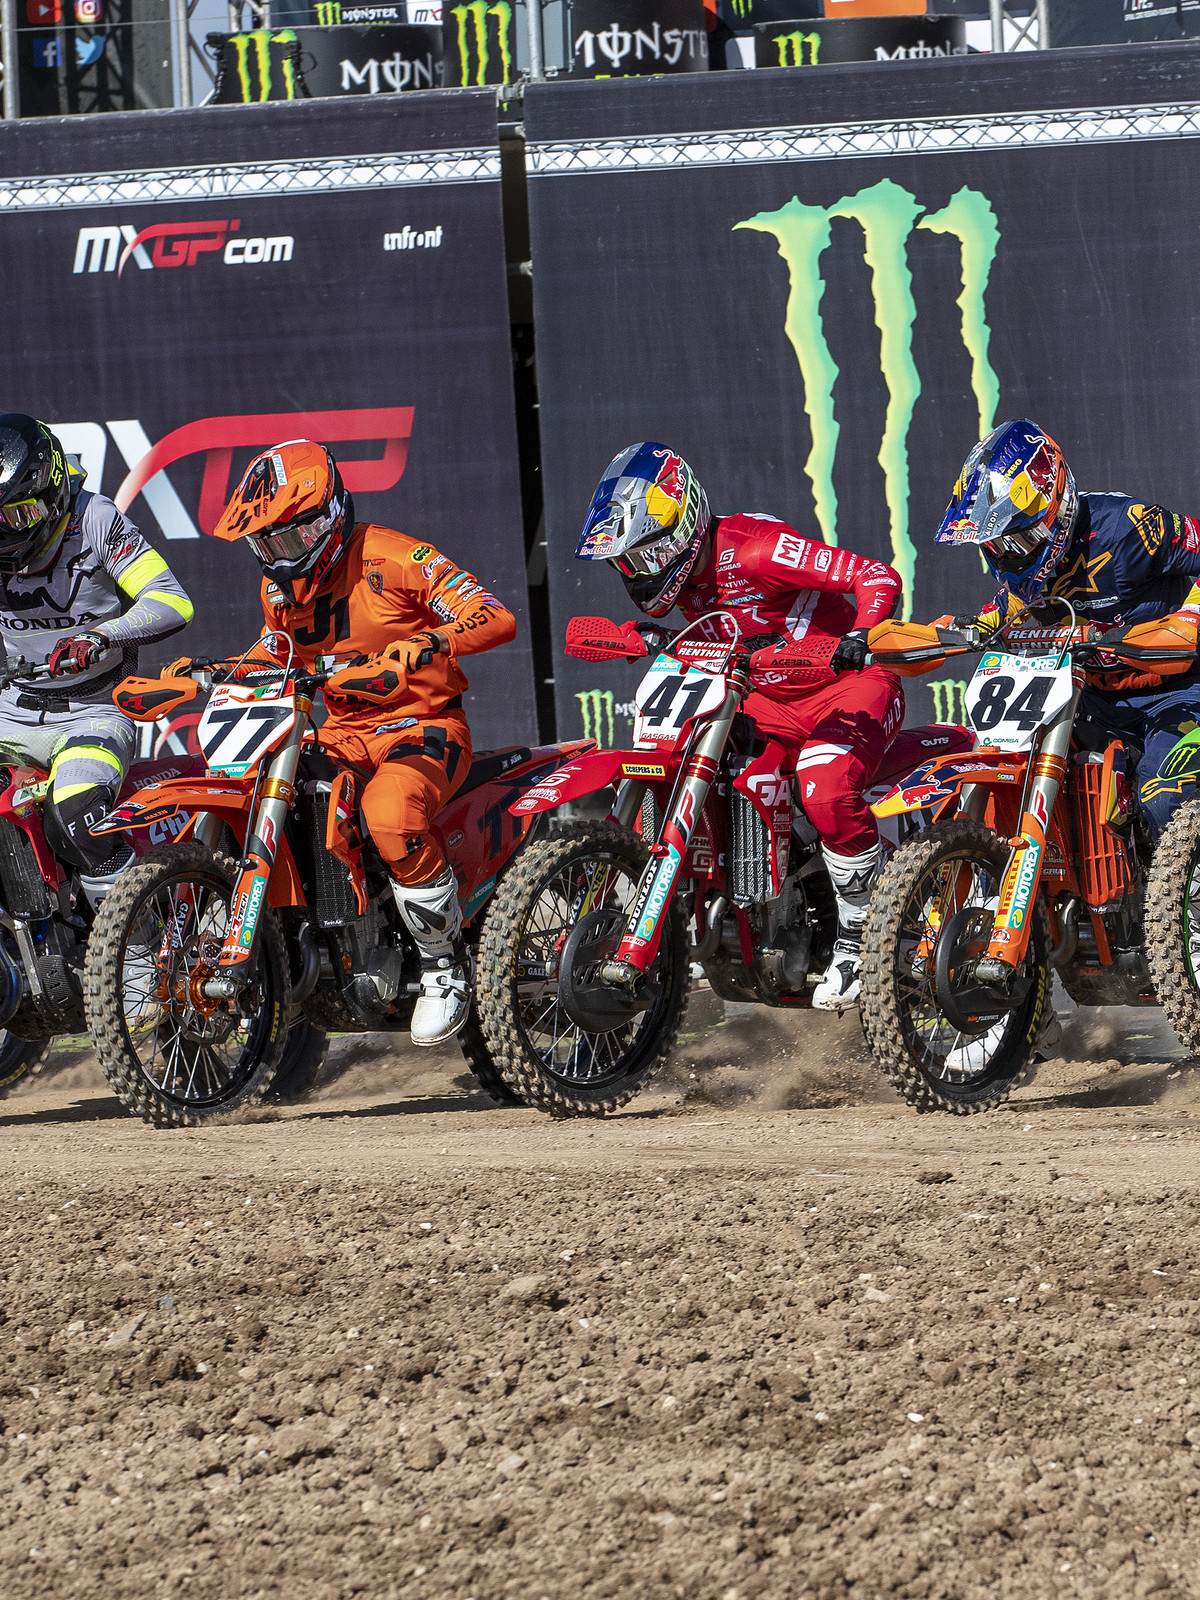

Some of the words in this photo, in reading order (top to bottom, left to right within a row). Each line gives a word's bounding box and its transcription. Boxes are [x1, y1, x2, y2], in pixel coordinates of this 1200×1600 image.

[342, 8, 399, 21] MONSTER
[273, 454, 287, 486] POLIZIA
[985, 511, 999, 536] AIROH
[778, 535, 801, 562] MX
[582, 639, 627, 650] ACERBIS
[1008, 629, 1082, 639] RENTHAL
[770, 658, 813, 667] ACERBIS
[215, 688, 230, 697] KTM
[639, 675, 714, 729] 41
[971, 676, 1056, 732] 84
[203, 705, 294, 762] 77
[641, 733, 677, 741] GASGAS
[920, 737, 950, 747] GUTS
[132, 767, 182, 790] HONDA
[625, 765, 651, 775] SCHEPERS
[647, 855, 679, 918] MOTOREX
[997, 859, 1020, 916] PIRELLI
[1014, 844, 1040, 909] MOTOREX
[244, 879, 265, 929] MOTOREX
[627, 860, 658, 932] DUNLOP
[1027, 965, 1046, 1044] PIRELLI
